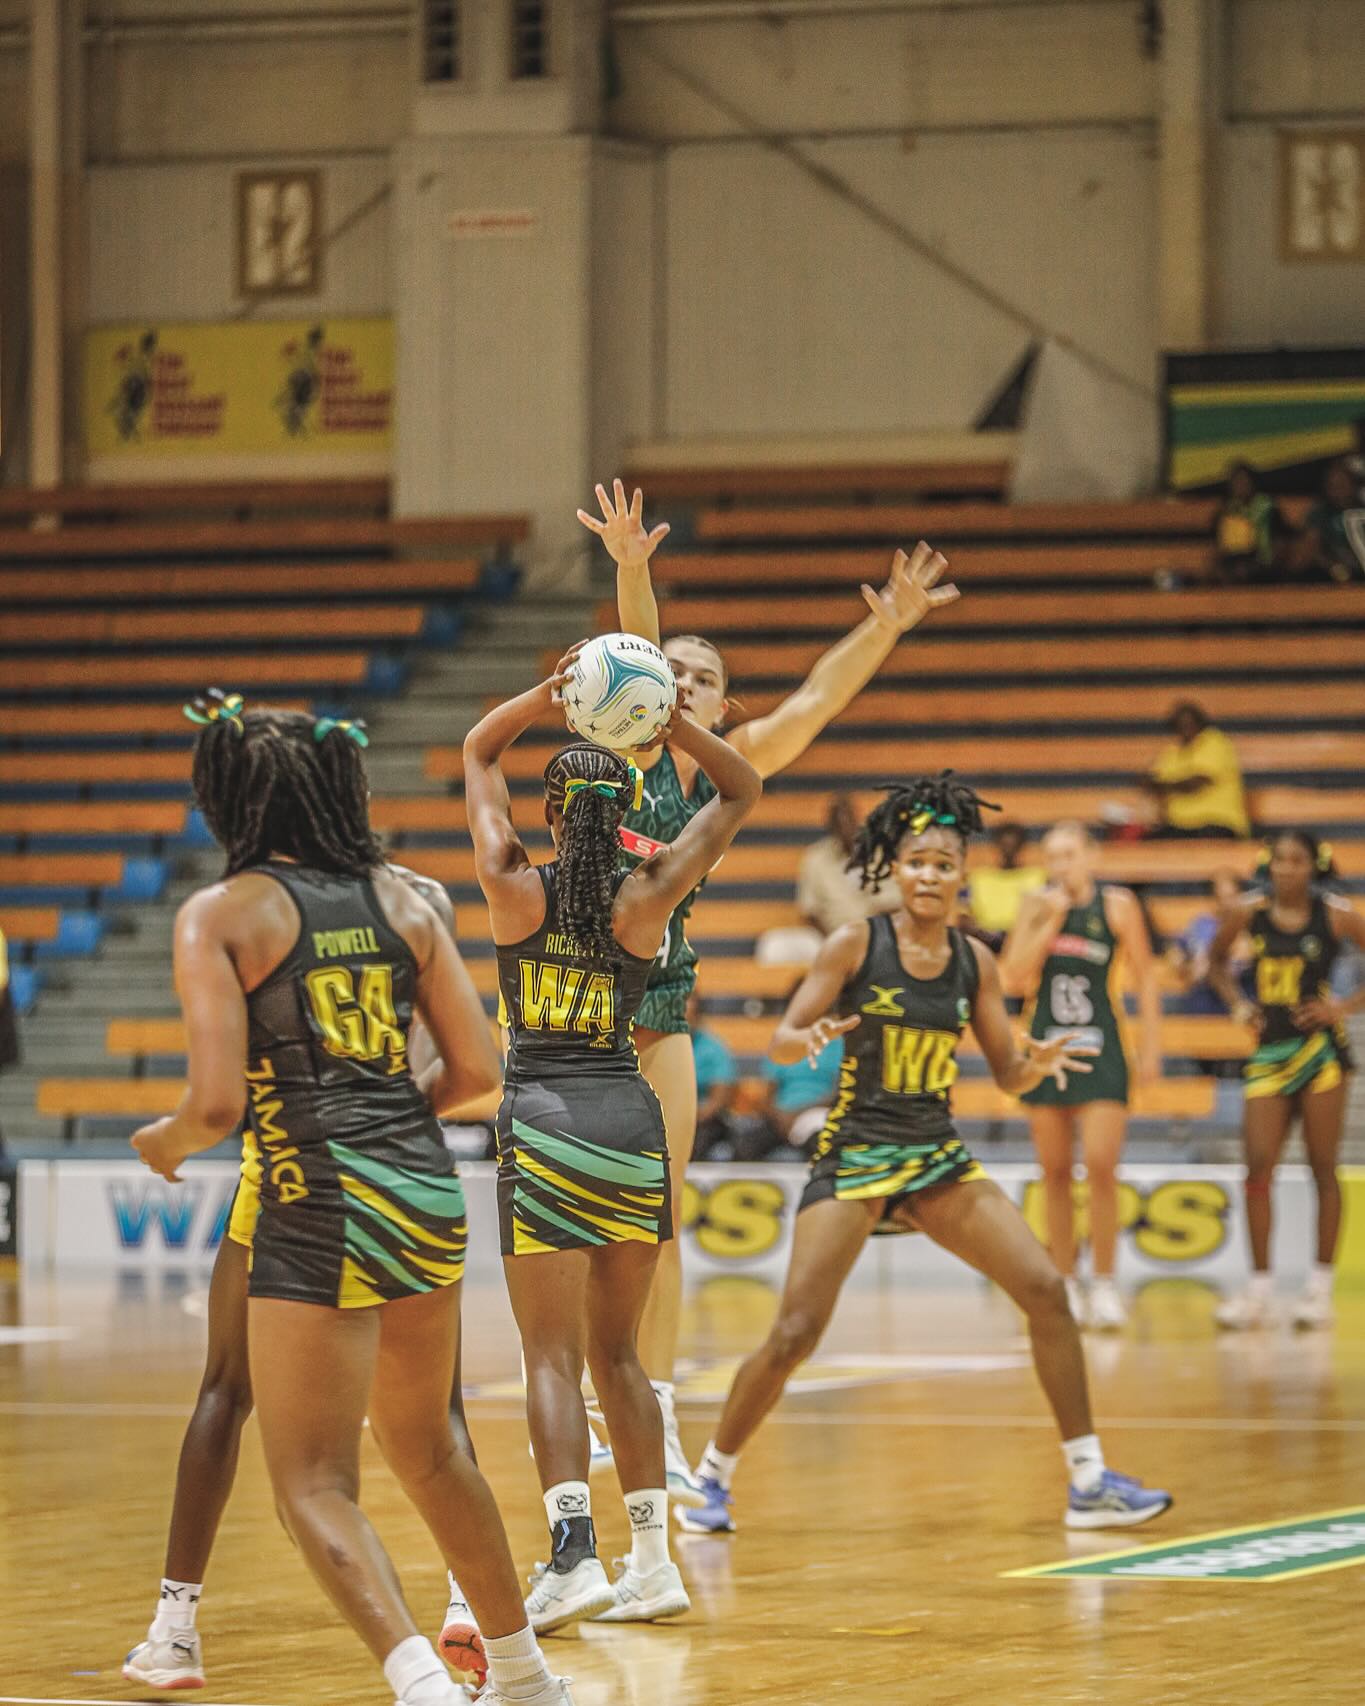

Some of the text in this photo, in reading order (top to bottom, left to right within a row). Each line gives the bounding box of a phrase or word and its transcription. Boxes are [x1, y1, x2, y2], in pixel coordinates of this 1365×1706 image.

[617, 641, 668, 664] BERT
[313, 927, 380, 959] POWELL
[306, 964, 406, 1060] GA
[519, 959, 615, 1034] WA
